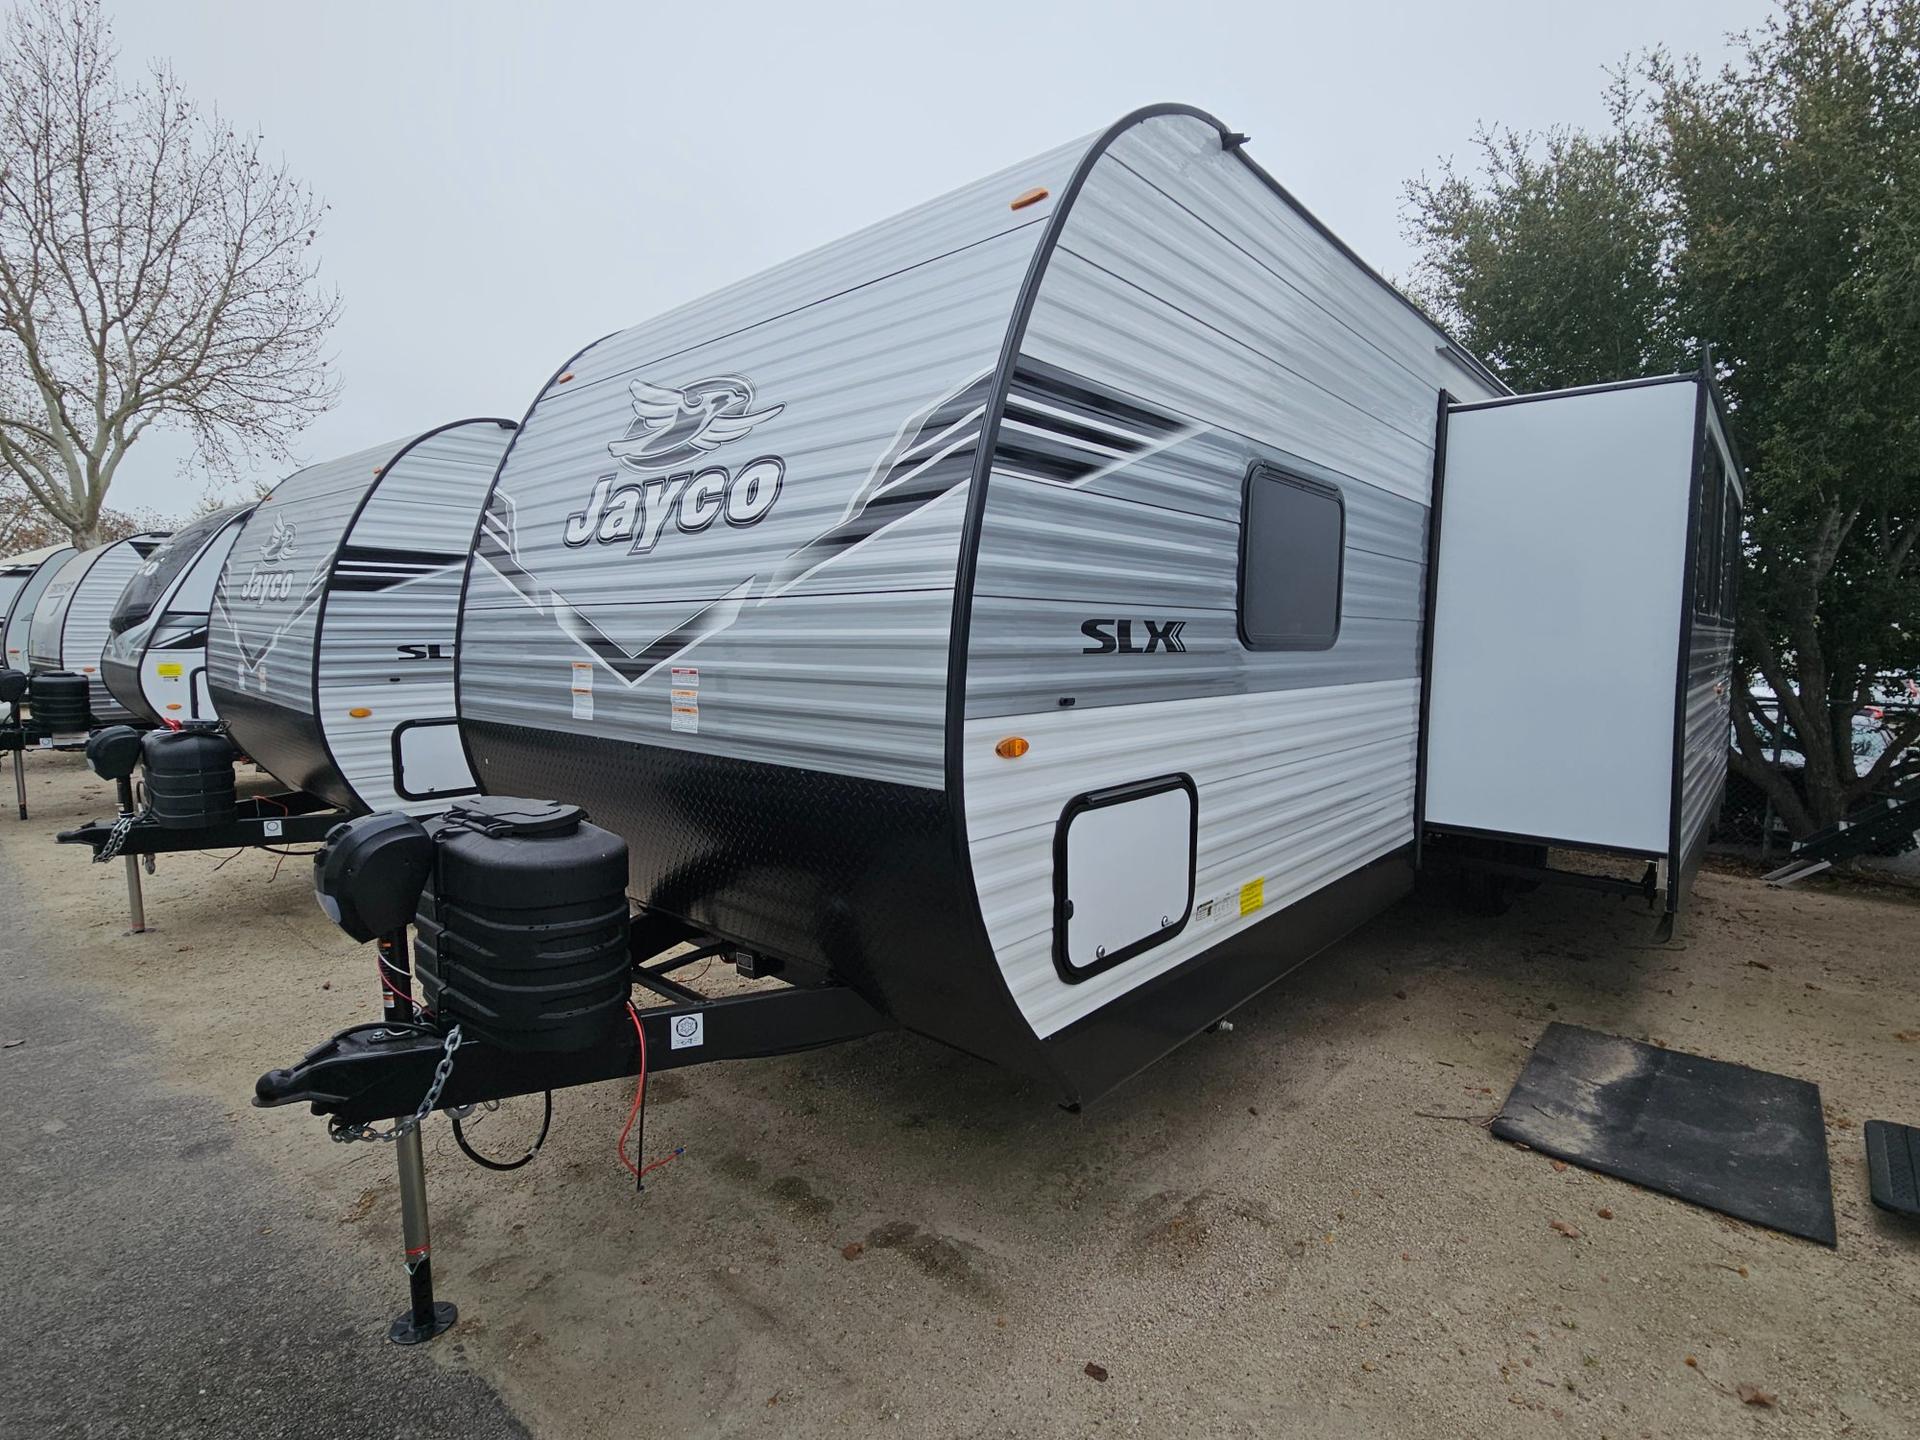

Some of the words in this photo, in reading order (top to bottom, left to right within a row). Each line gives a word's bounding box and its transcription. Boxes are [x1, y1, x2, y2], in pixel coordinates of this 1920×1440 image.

[563, 455, 786, 555] Jayco
[242, 565, 296, 607] Jayco
[397, 644, 456, 660] SL
[1081, 618, 1187, 654] SLX
